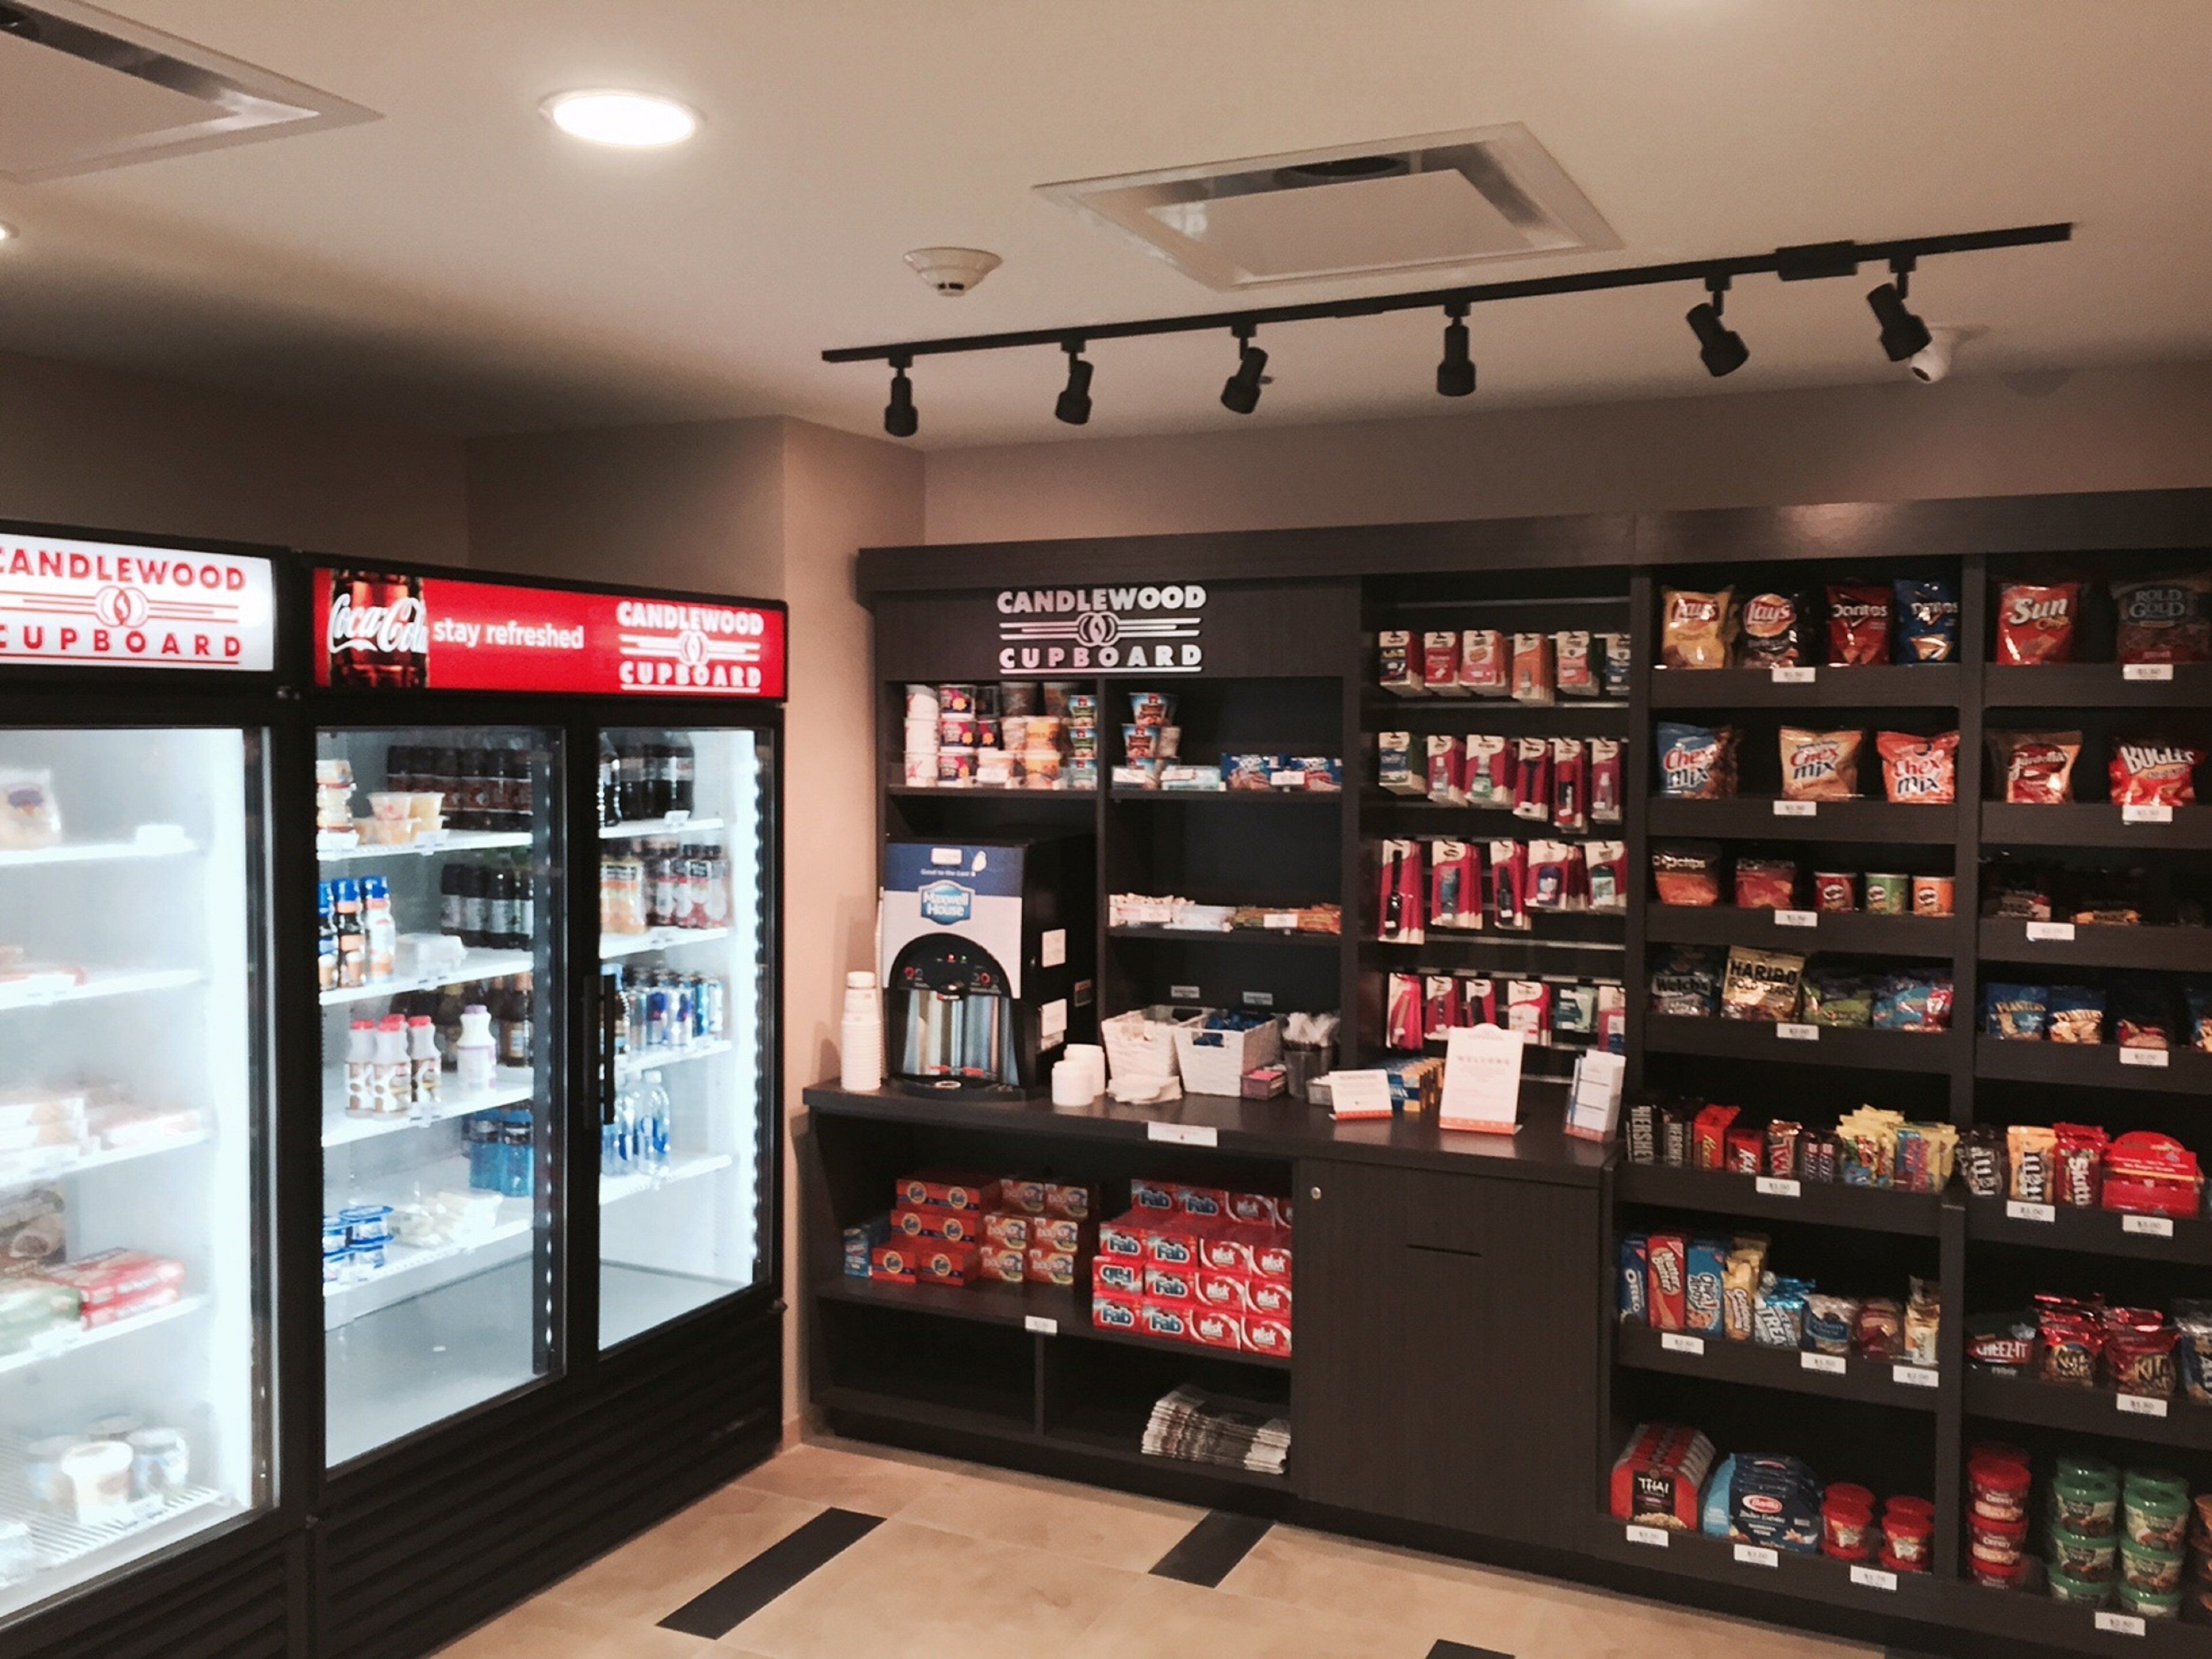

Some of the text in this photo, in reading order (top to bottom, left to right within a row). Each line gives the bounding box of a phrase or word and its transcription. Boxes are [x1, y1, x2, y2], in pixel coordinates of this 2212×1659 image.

[997, 585, 1207, 614] CANDLEWOOD
[2135, 589, 2183, 602] ROLD
[616, 601, 764, 638] CANDLEWOOD
[1832, 604, 1888, 618] Doritos
[2009, 597, 2069, 624] Sun
[2130, 603, 2185, 618] GOLD
[328, 593, 427, 654] Coca-Cola
[433, 618, 584, 650] stay refreshed
[999, 644, 1202, 669] CUPBOARD
[619, 661, 762, 688] CUPBOARD
[1790, 748, 1839, 767] Chex
[1893, 759, 1941, 777] Chex
[923, 891, 969, 906] Maxwell
[926, 903, 965, 917] House
[1730, 960, 1797, 986] HARIBO
[1141, 1190, 1169, 1207] Fab
[1109, 1235, 1138, 1253] Fab
[1157, 1243, 1187, 1262] Fab
[1155, 1278, 1185, 1296] Fab
[1102, 1306, 1132, 1324] Fab
[1152, 1315, 1182, 1332] Fab
[1638, 1476, 1670, 1494] THAI
